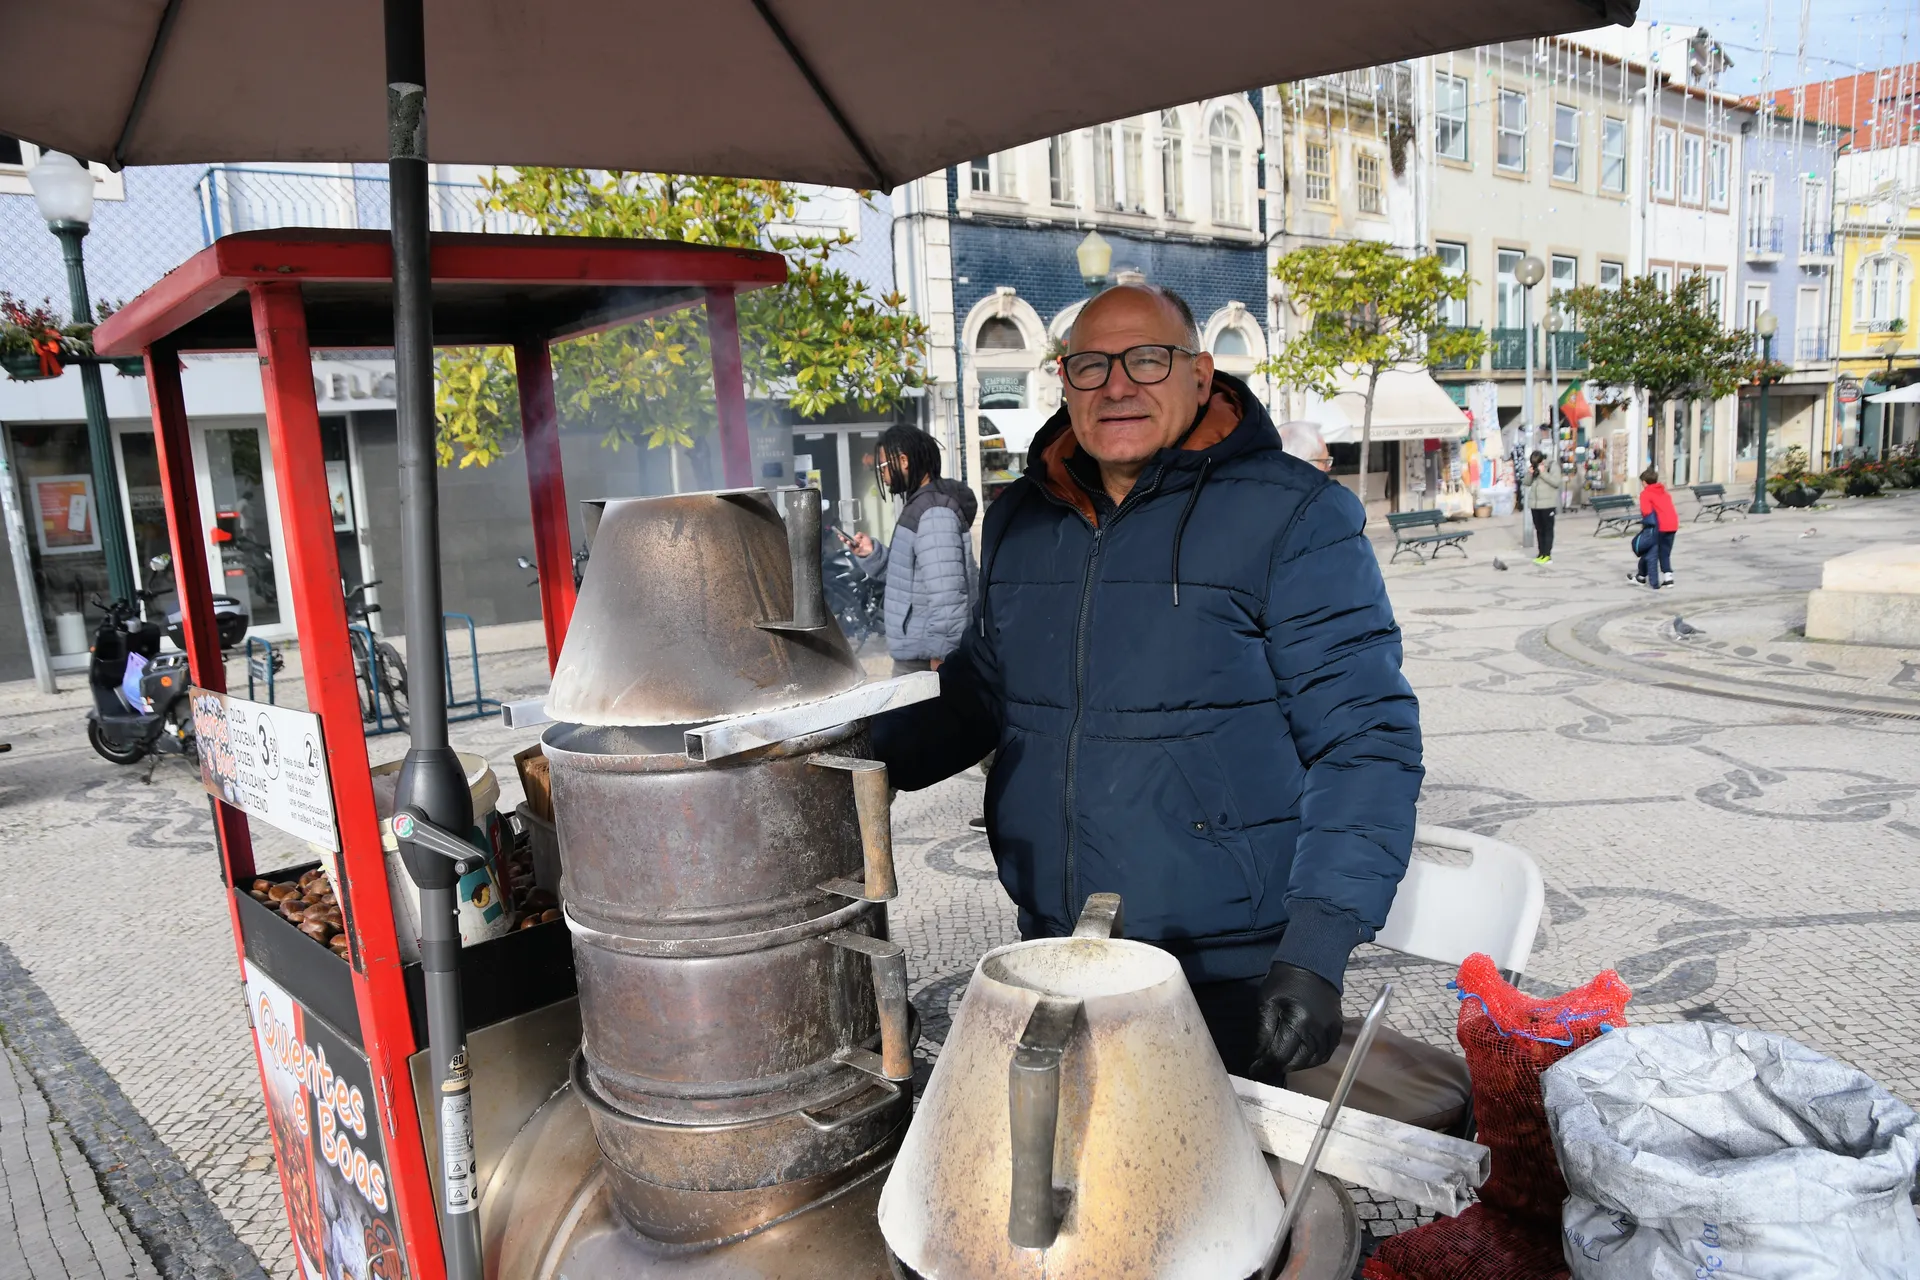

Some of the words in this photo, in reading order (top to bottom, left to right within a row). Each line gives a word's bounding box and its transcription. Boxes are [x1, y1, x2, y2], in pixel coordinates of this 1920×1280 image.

[233, 728, 257, 747] DOCENA
[236, 749, 256, 769] DOZEN
[239, 769, 269, 794] DOUZAINE
[242, 790, 269, 813] DUTZEND
[259, 991, 367, 1139] Quentes
[452, 1054, 464, 1066] 80
[293, 1091, 309, 1137] e
[317, 1098, 388, 1213] Boas
